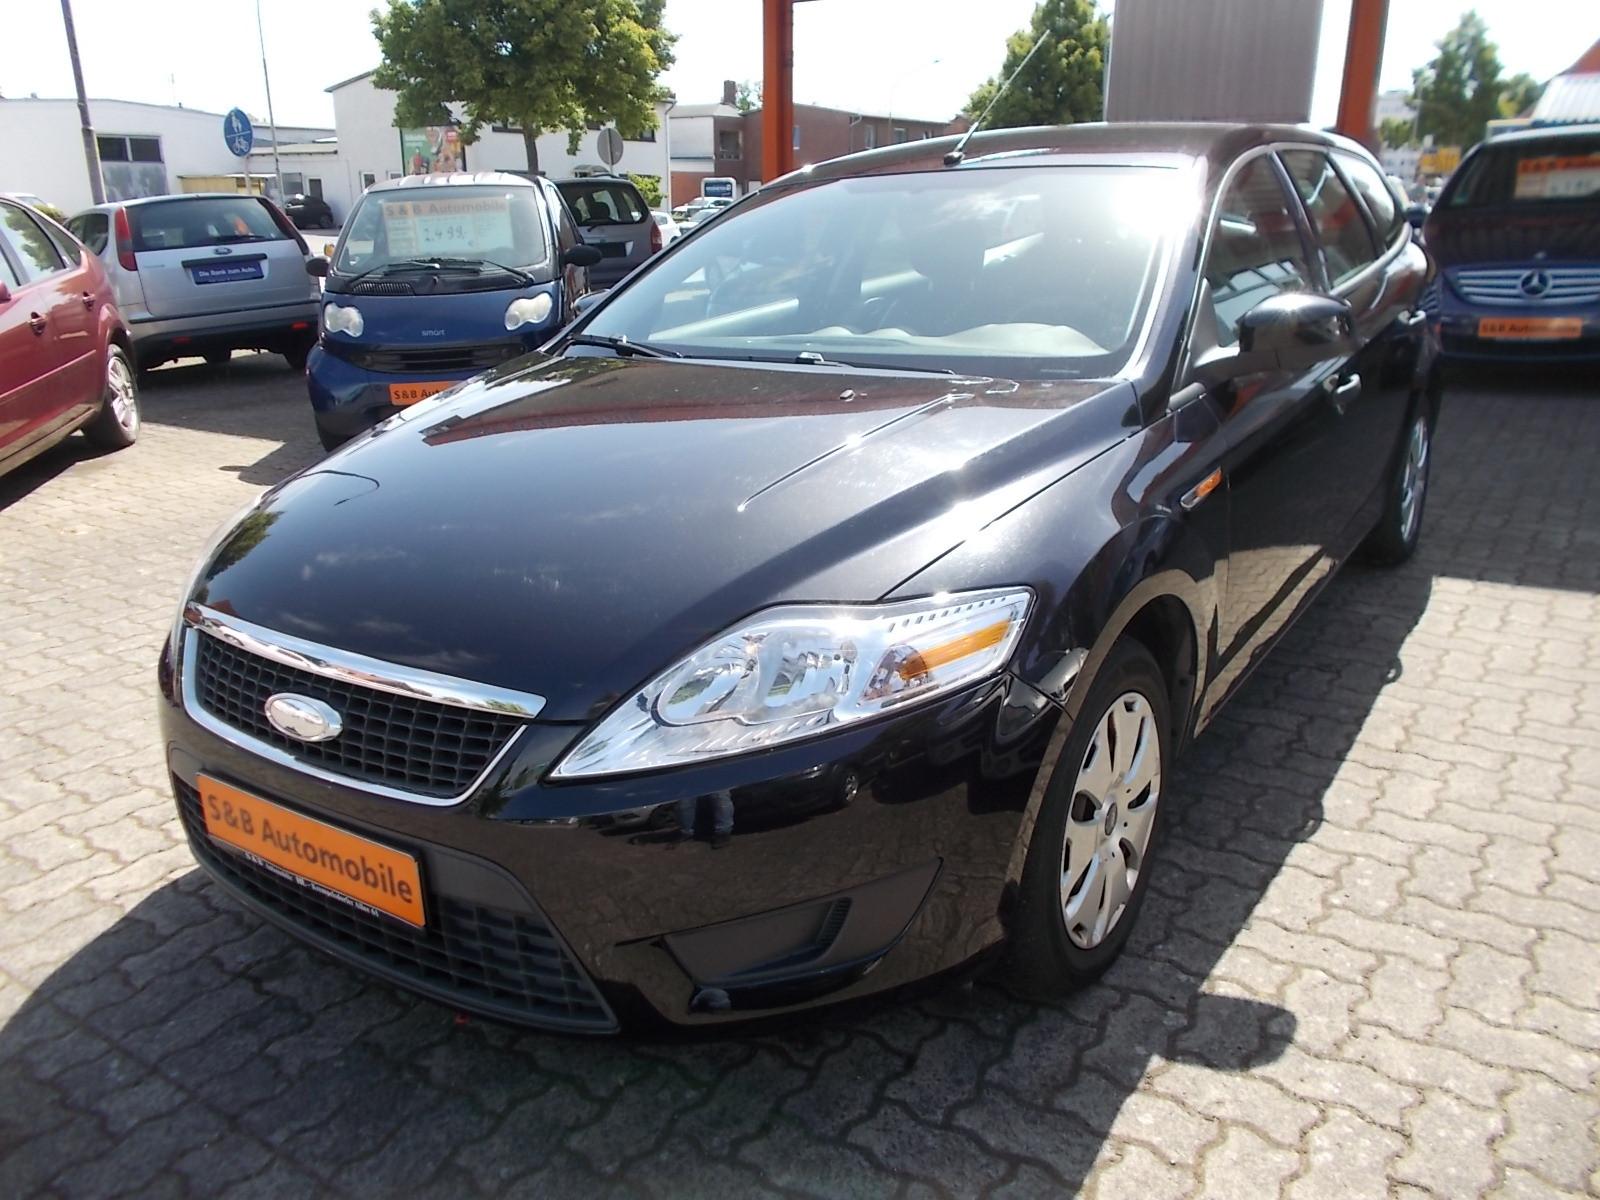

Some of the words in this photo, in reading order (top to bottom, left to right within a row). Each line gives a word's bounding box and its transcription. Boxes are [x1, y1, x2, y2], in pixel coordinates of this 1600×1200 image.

[421, 328, 446, 337] smart
[393, 389, 418, 400] S&B
[207, 794, 255, 837] S&B
[261, 817, 414, 904] Automobile
